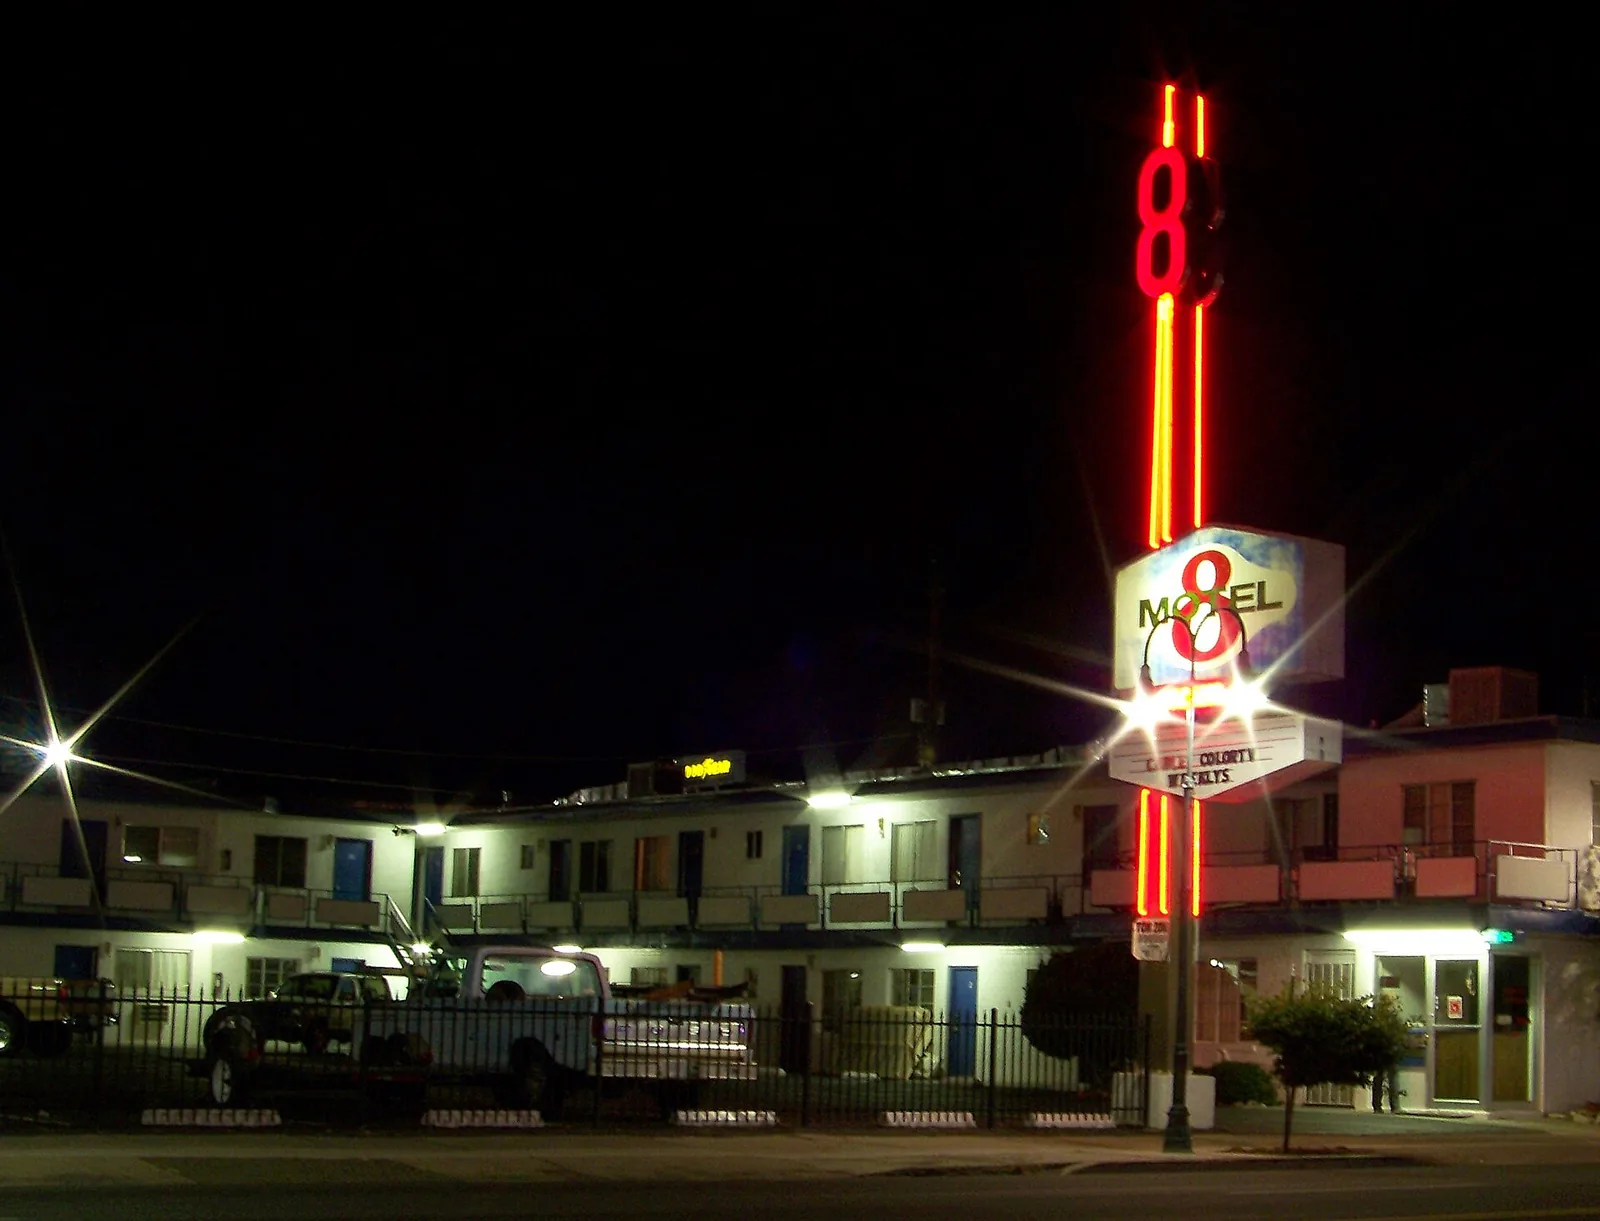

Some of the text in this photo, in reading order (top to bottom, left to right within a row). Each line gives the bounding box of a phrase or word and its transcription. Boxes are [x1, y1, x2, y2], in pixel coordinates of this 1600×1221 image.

[1137, 146, 1187, 298] 8
[1139, 580, 1283, 628] MOTEL
[1171, 550, 1243, 662] 8
